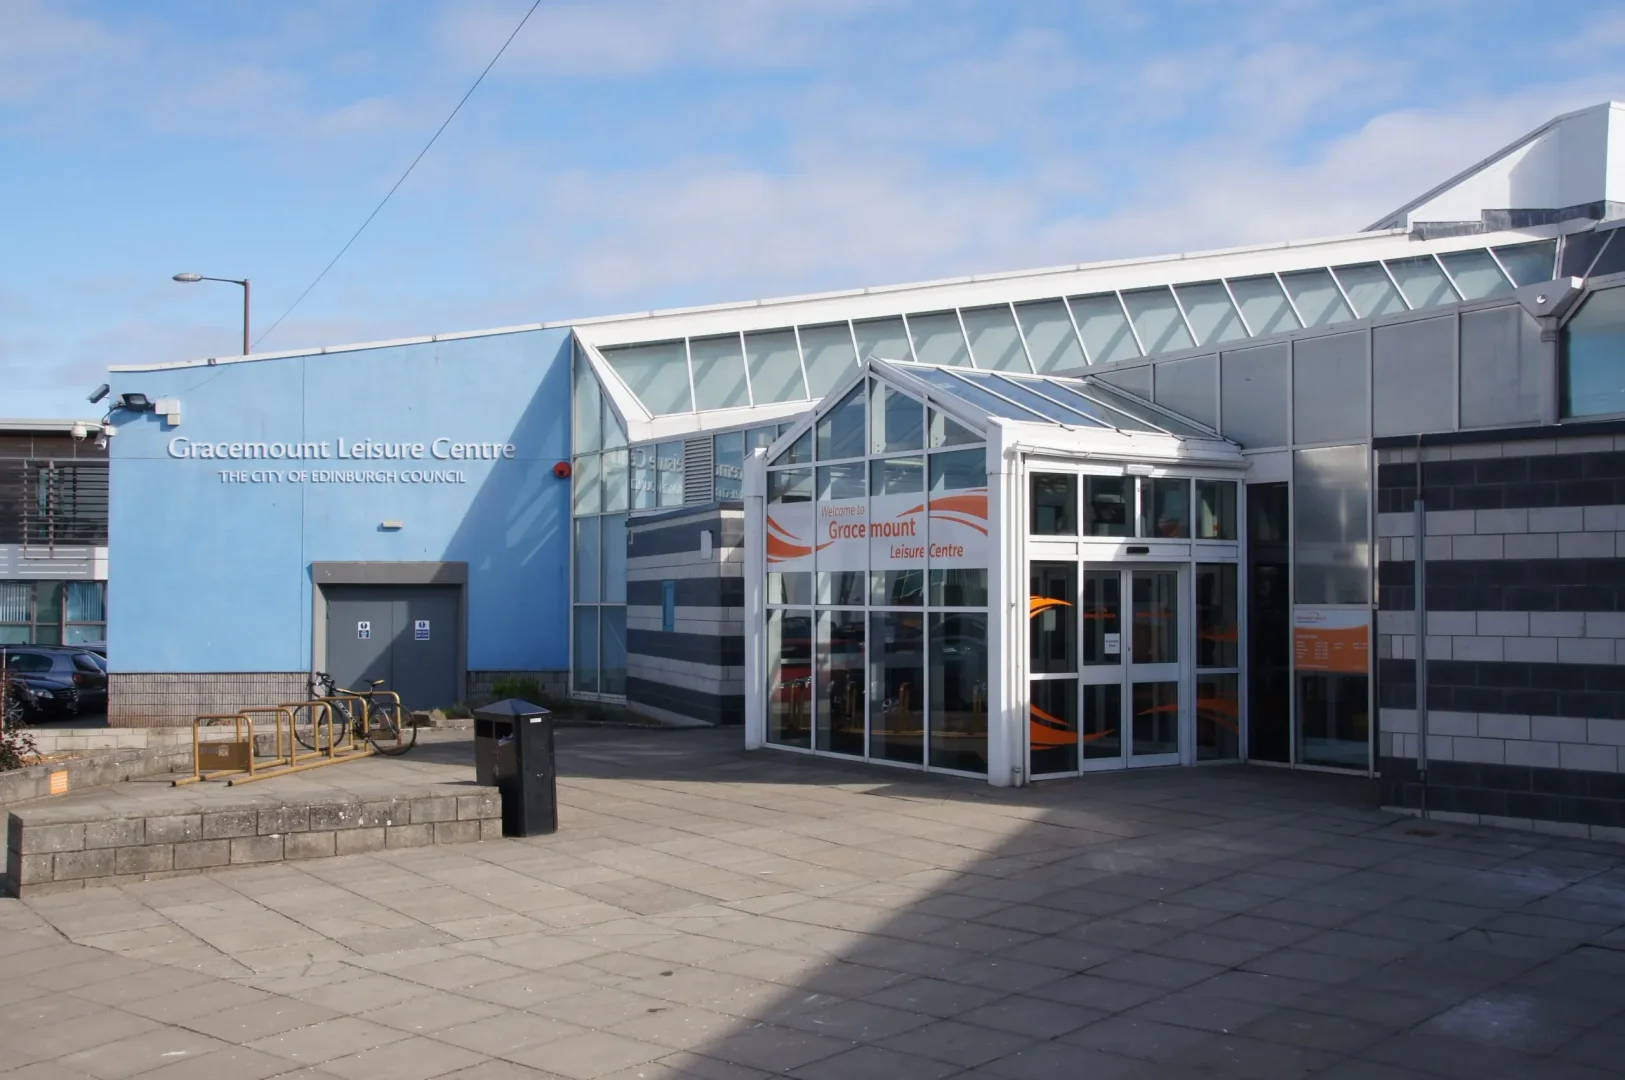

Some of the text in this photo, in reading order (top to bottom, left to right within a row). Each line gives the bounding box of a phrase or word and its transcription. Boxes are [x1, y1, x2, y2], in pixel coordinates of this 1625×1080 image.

[167, 437, 516, 459] Gracemount Leisure Centre
[218, 470, 467, 483] THE CITY OF EDINBURGH COUNCIL
[821, 505, 865, 517] Welcome to
[890, 544, 964, 560] Leisure Centre
